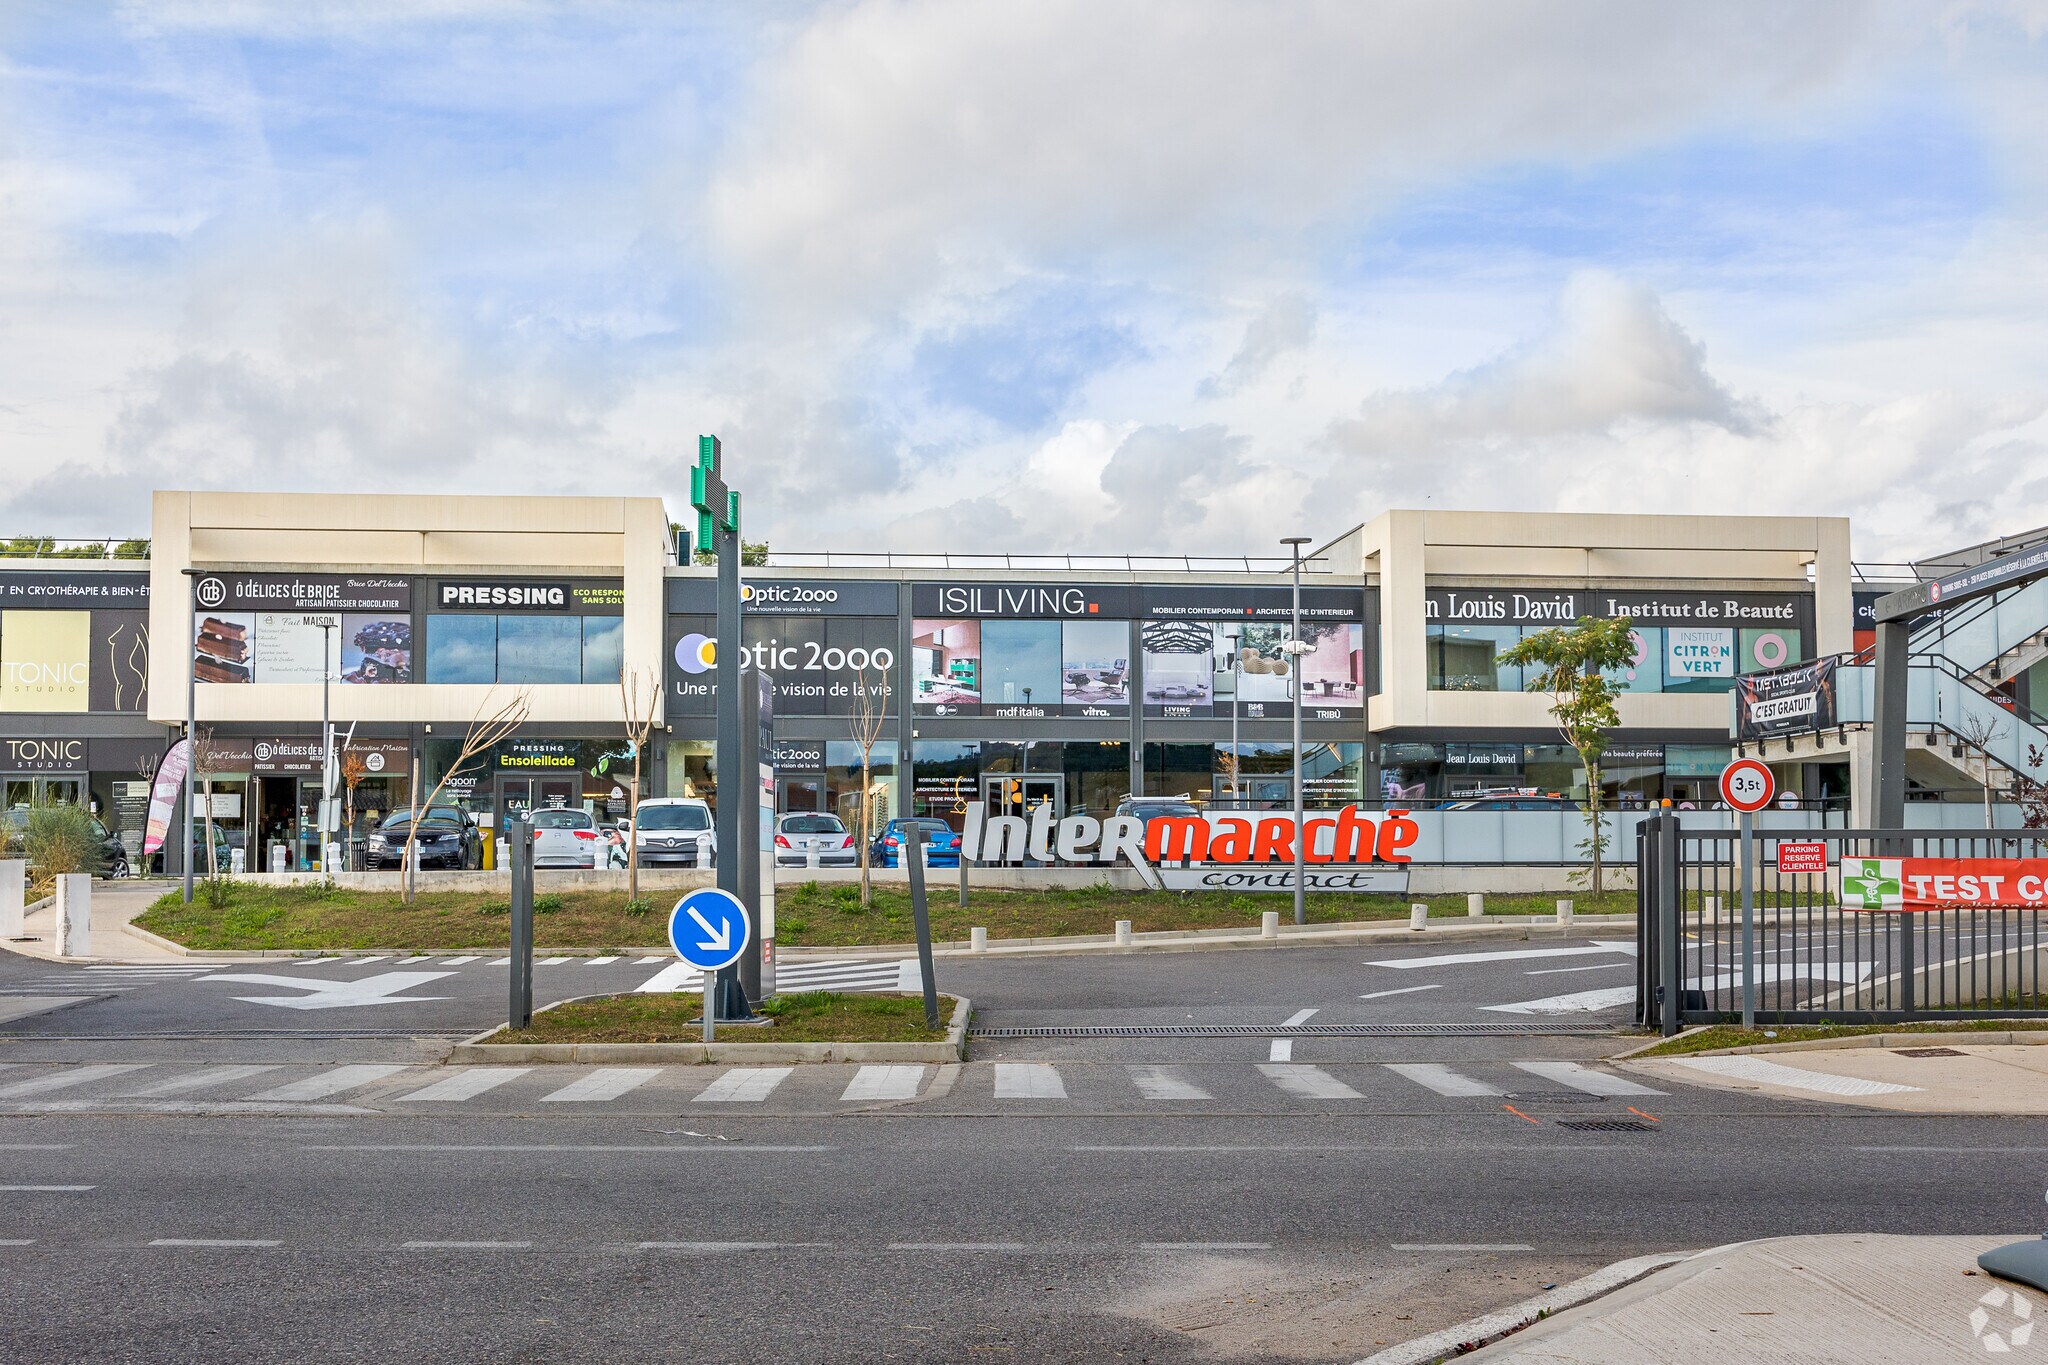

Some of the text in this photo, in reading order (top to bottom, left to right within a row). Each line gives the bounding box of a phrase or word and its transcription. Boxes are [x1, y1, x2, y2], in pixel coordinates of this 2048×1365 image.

[381, 579, 408, 588] Vecchio
[10, 586, 24, 595] EN
[28, 584, 98, 596] CRYOTHÉRAPIE
[101, 587, 109, 596] &
[443, 586, 564, 605] PRESSING
[573, 589, 590, 597] ECO
[741, 585, 790, 606] Optic
[308, 585, 340, 607] BRICE
[295, 599, 400, 608] ARTISAN PATISSIER CHOCOLATIER
[1448, 593, 1506, 619] Louis
[1512, 595, 1576, 620] David
[1607, 599, 1794, 619] Institut de Beauté
[1256, 608, 1310, 616] ARCHITECTRE
[303, 616, 335, 626] MAISON
[1680, 632, 1724, 642] INSTITUT
[1674, 645, 1730, 657] CITRON
[1683, 661, 1721, 672] VERT
[5, 662, 87, 684] TONIC
[676, 682, 708, 695] Une
[781, 682, 825, 696] vision
[830, 682, 848, 696] de
[853, 682, 865, 696] la
[870, 682, 892, 696] vie
[996, 706, 1044, 717] mdf italia
[1315, 708, 1341, 719] TRIBÙ
[1756, 697, 1811, 719] C'EST GRATUIT
[6, 740, 82, 760] TONIC
[381, 744, 408, 752] Maison
[222, 751, 253, 760] Vecchio
[1446, 753, 1516, 764] Jean Louis David
[1613, 749, 1635, 757] beauté
[1636, 750, 1663, 759] préférée
[501, 755, 576, 767] Ensoleillade
[508, 800, 530, 809] EAU
[1785, 846, 1820, 854] PARKING
[1784, 854, 1821, 862] RESERVE
[1781, 862, 1824, 870] CLIENTELE
[1202, 871, 1374, 889] contact
[1908, 875, 2048, 901] TEST C
